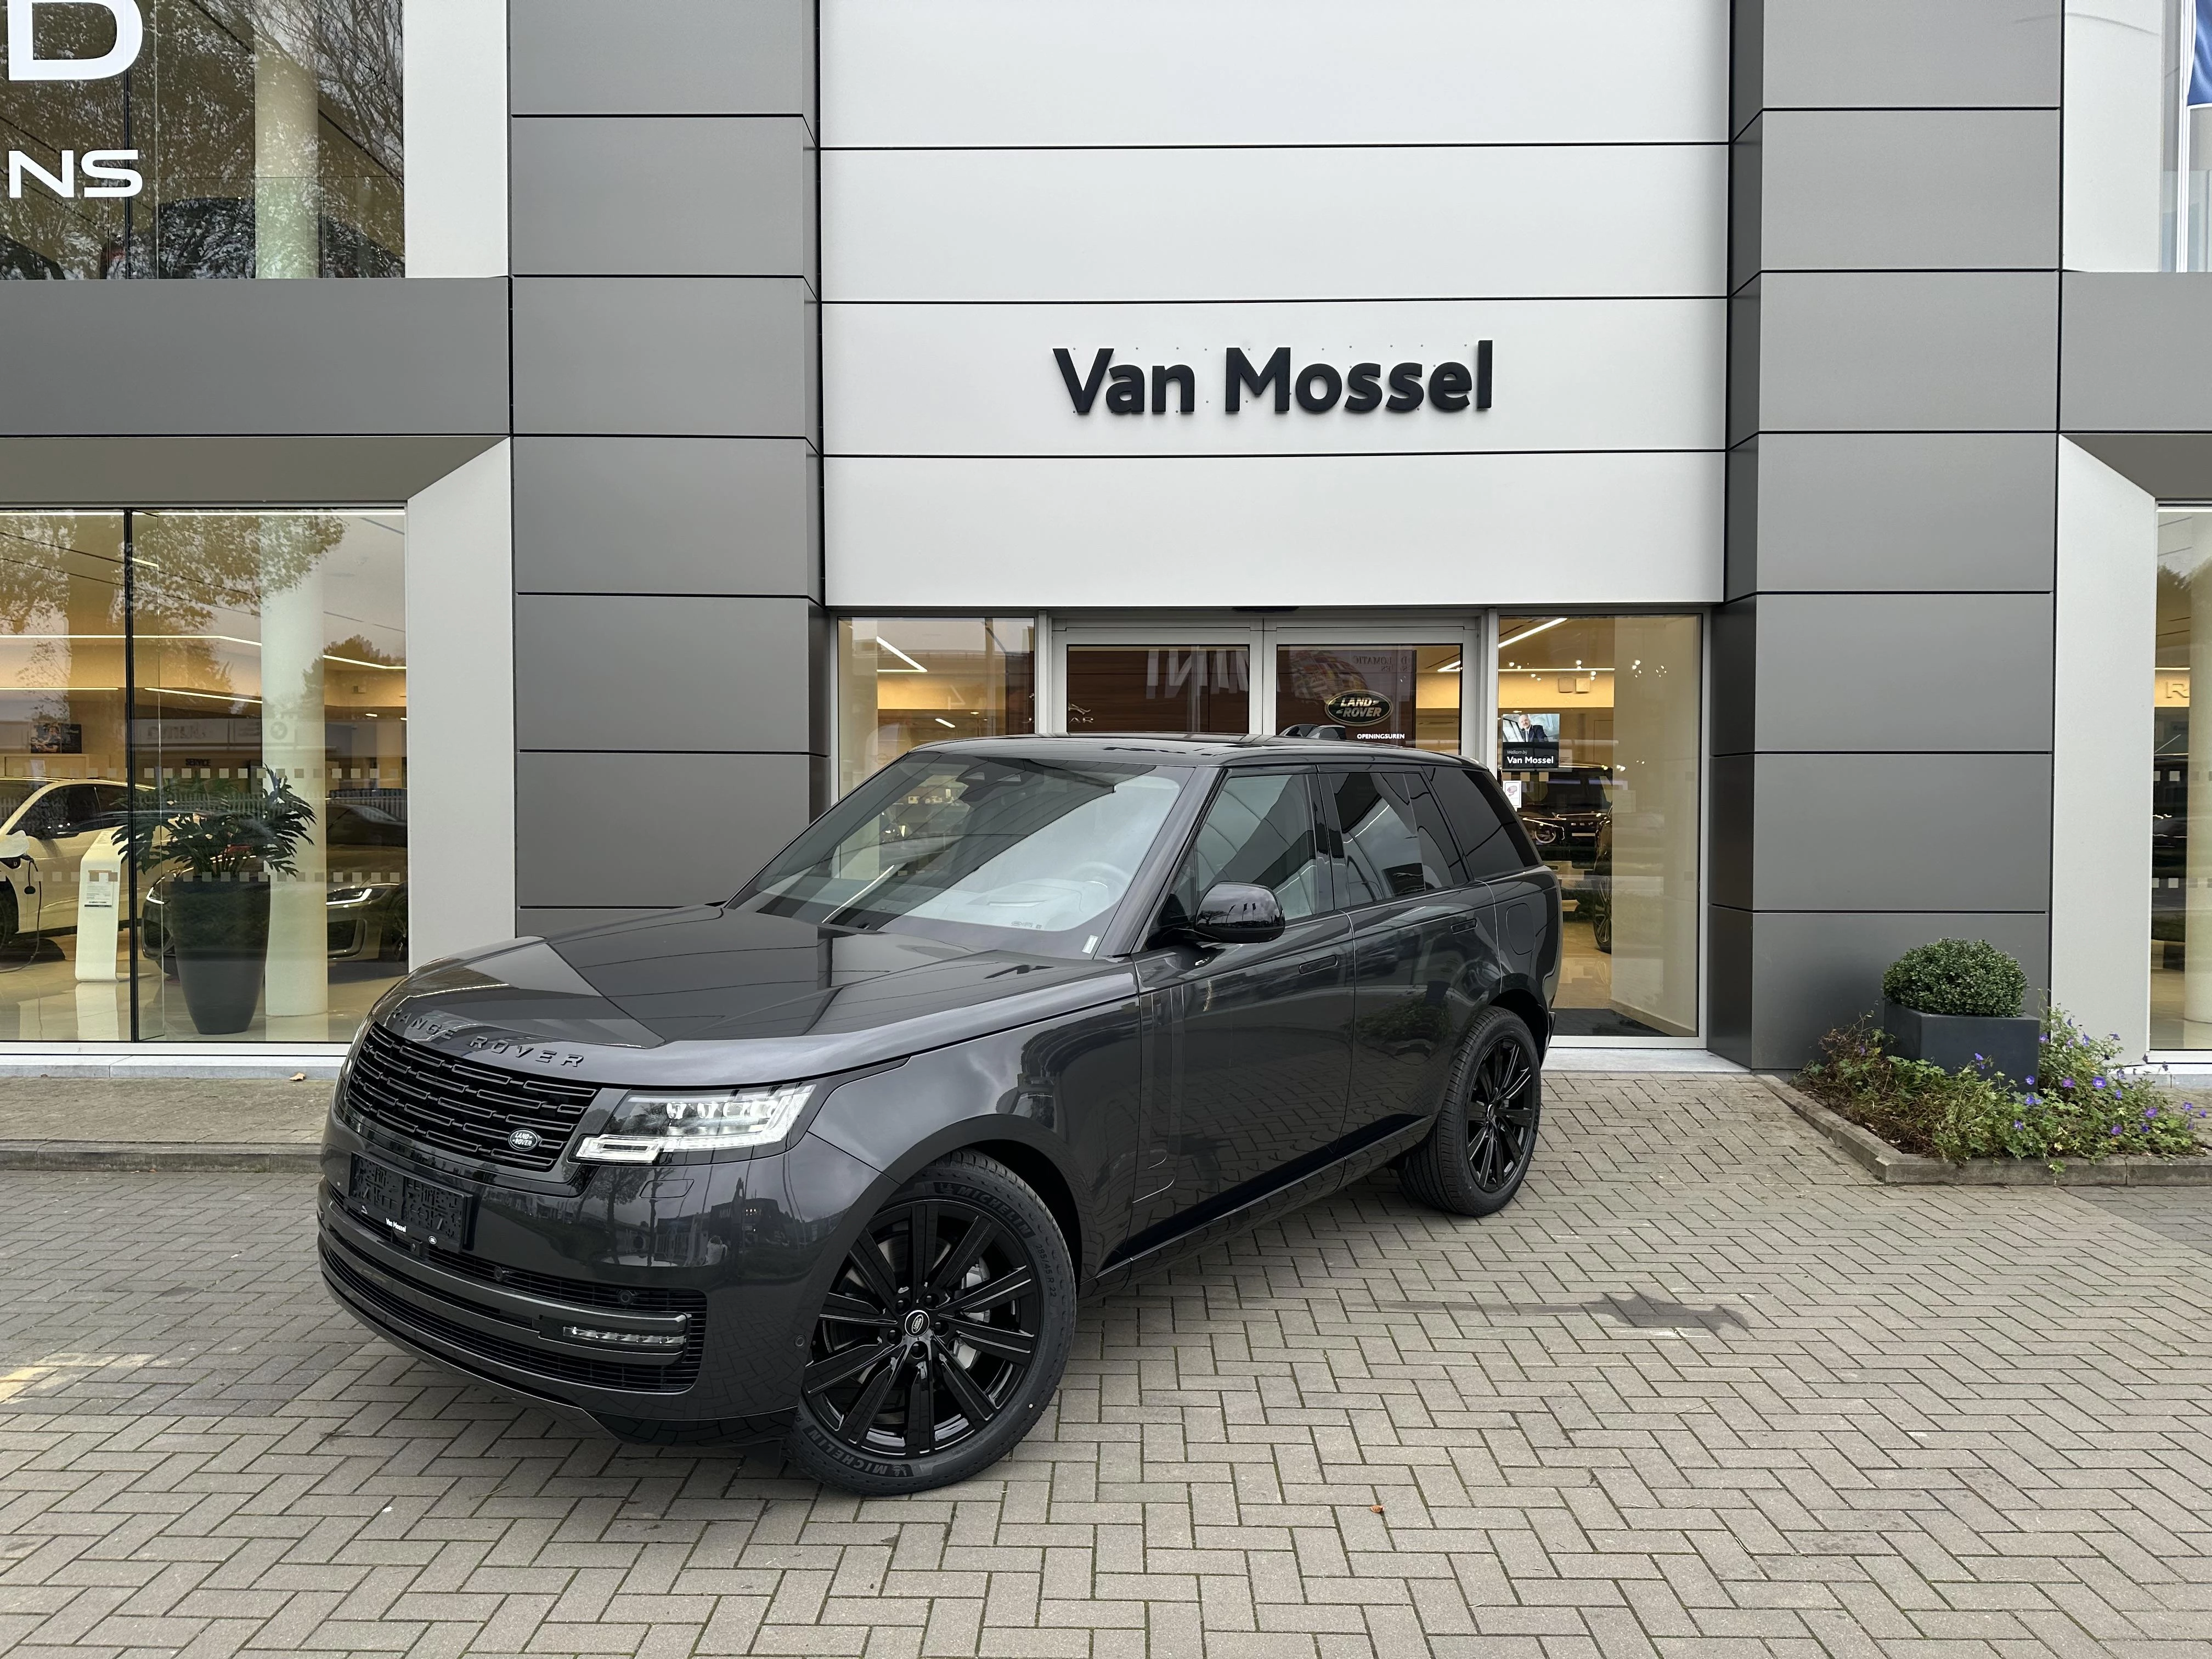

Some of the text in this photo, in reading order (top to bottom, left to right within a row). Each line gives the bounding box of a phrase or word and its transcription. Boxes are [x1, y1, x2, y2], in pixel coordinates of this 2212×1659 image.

[8, 0, 144, 81] D
[9, 149, 143, 199] NS
[1052, 340, 1493, 413] Van Mossel
[1340, 697, 1373, 707] LAND
[1342, 707, 1382, 718] ROVER
[185, 758, 211, 766] SERVICE
[391, 1006, 584, 1068] RANGE ROVER
[514, 1138, 532, 1147] ROVER
[393, 1221, 407, 1233] Mossel
[956, 1186, 1032, 1236] MICHELIN
[1035, 1244, 1053, 1274] 285/45
[1049, 1286, 1057, 1297] 22
[808, 1429, 888, 1475] MICHELIN
